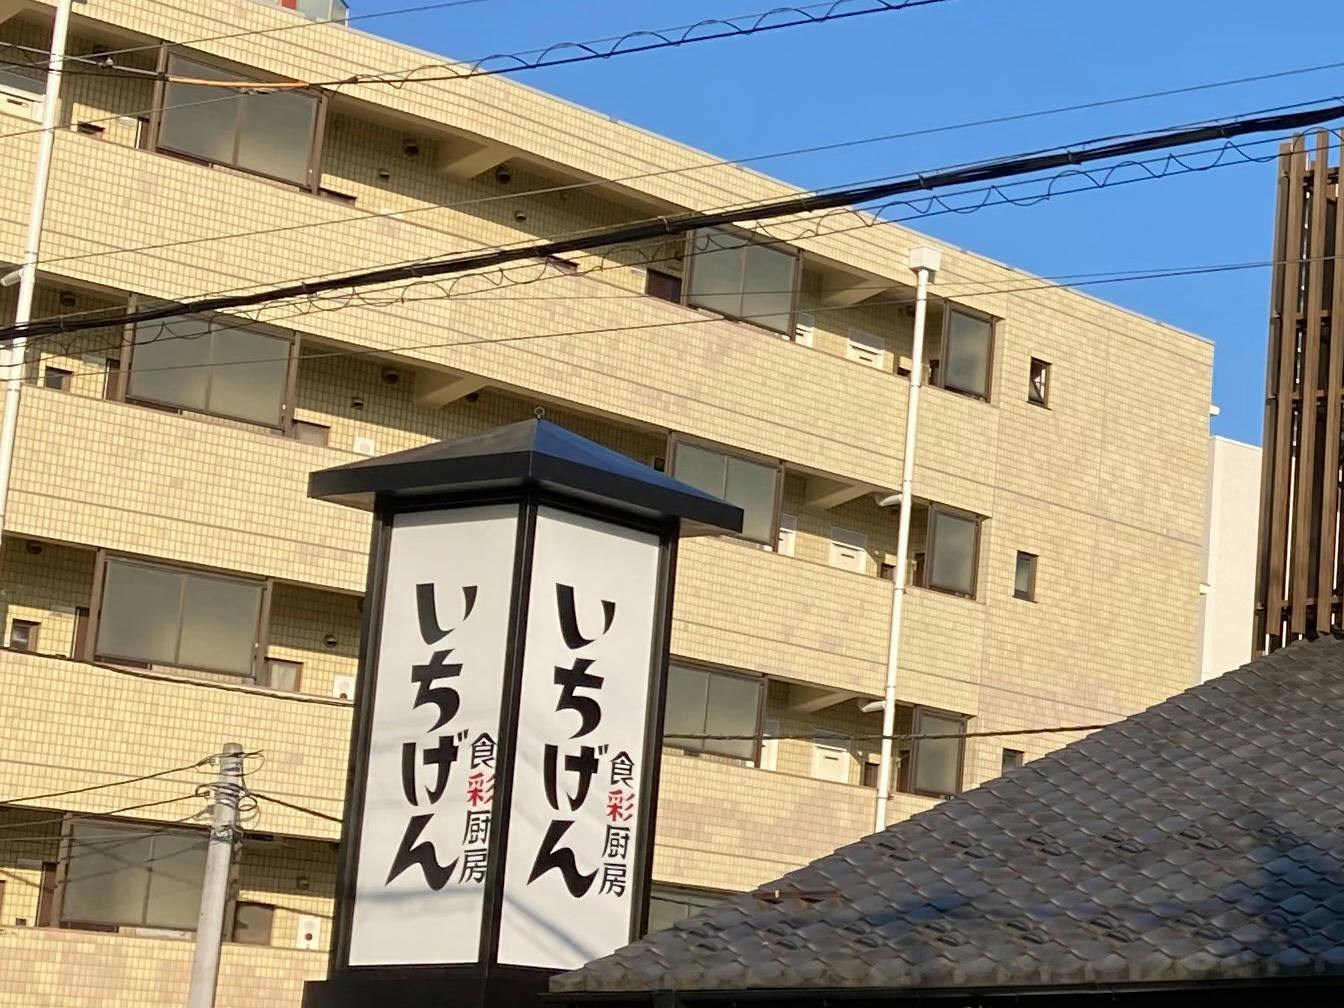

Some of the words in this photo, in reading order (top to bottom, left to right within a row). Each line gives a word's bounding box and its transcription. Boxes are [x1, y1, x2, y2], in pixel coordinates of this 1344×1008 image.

[385, 583, 478, 891] いちげん
[458, 732, 497, 884] 食彩厨房
[526, 583, 616, 898] いちげん
[598, 750, 635, 897] 食彩厨房
